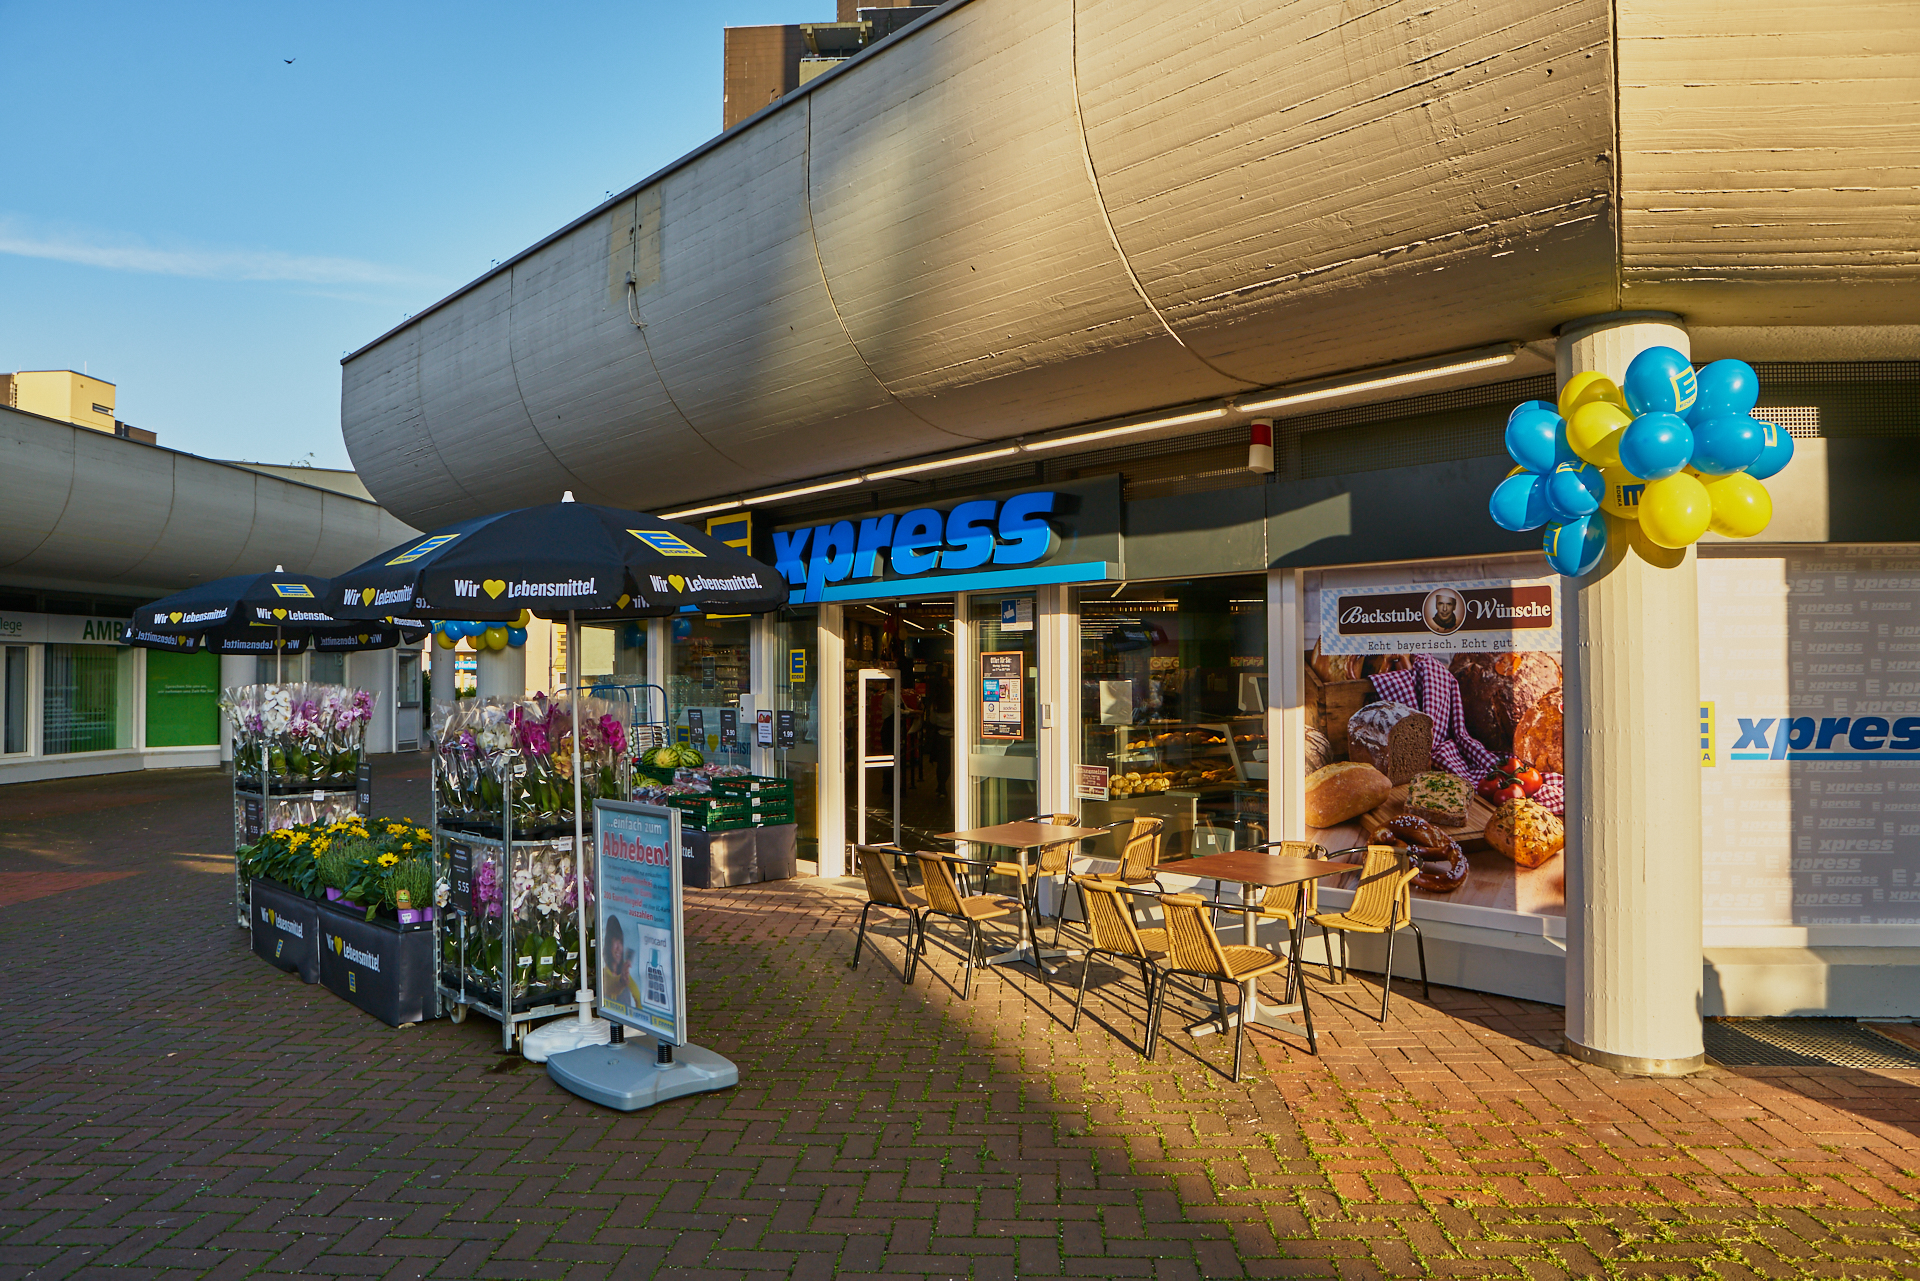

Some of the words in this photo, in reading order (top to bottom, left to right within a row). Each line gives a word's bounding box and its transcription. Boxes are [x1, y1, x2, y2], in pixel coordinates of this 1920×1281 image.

[772, 491, 1056, 603] xpress
[454, 579, 480, 598] Wir
[507, 577, 598, 599] Lebensmittel.
[650, 574, 669, 593] Wir
[684, 573, 763, 593] Lebensmittel.
[343, 588, 361, 606] Wir
[256, 607, 272, 620] Wir
[1340, 606, 1422, 625] Backstube
[1467, 598, 1551, 619] Wünsche
[1797, 603, 1853, 615] xpress
[154, 613, 169, 625] Wir
[1814, 621, 1870, 633] xpress
[1368, 641, 1391, 651] Echt
[1397, 640, 1457, 652] bayerisch.
[1461, 639, 1487, 649] Echt
[1493, 639, 1518, 649] gut.
[1807, 642, 1864, 655] xpress
[1808, 664, 1865, 675] xpress
[1808, 681, 1858, 692] xpress
[1825, 782, 1883, 795] xpress
[607, 815, 642, 831] ...einfach
[644, 822, 662, 835] zum
[1818, 817, 1876, 830] xpress
[602, 830, 670, 867] Abheben!
[1818, 839, 1895, 854] xpress
[458, 880, 470, 894] 5.55
[1826, 876, 1879, 887] xpress
[1794, 893, 1863, 907] xpress
[644, 935, 667, 947] girocard
